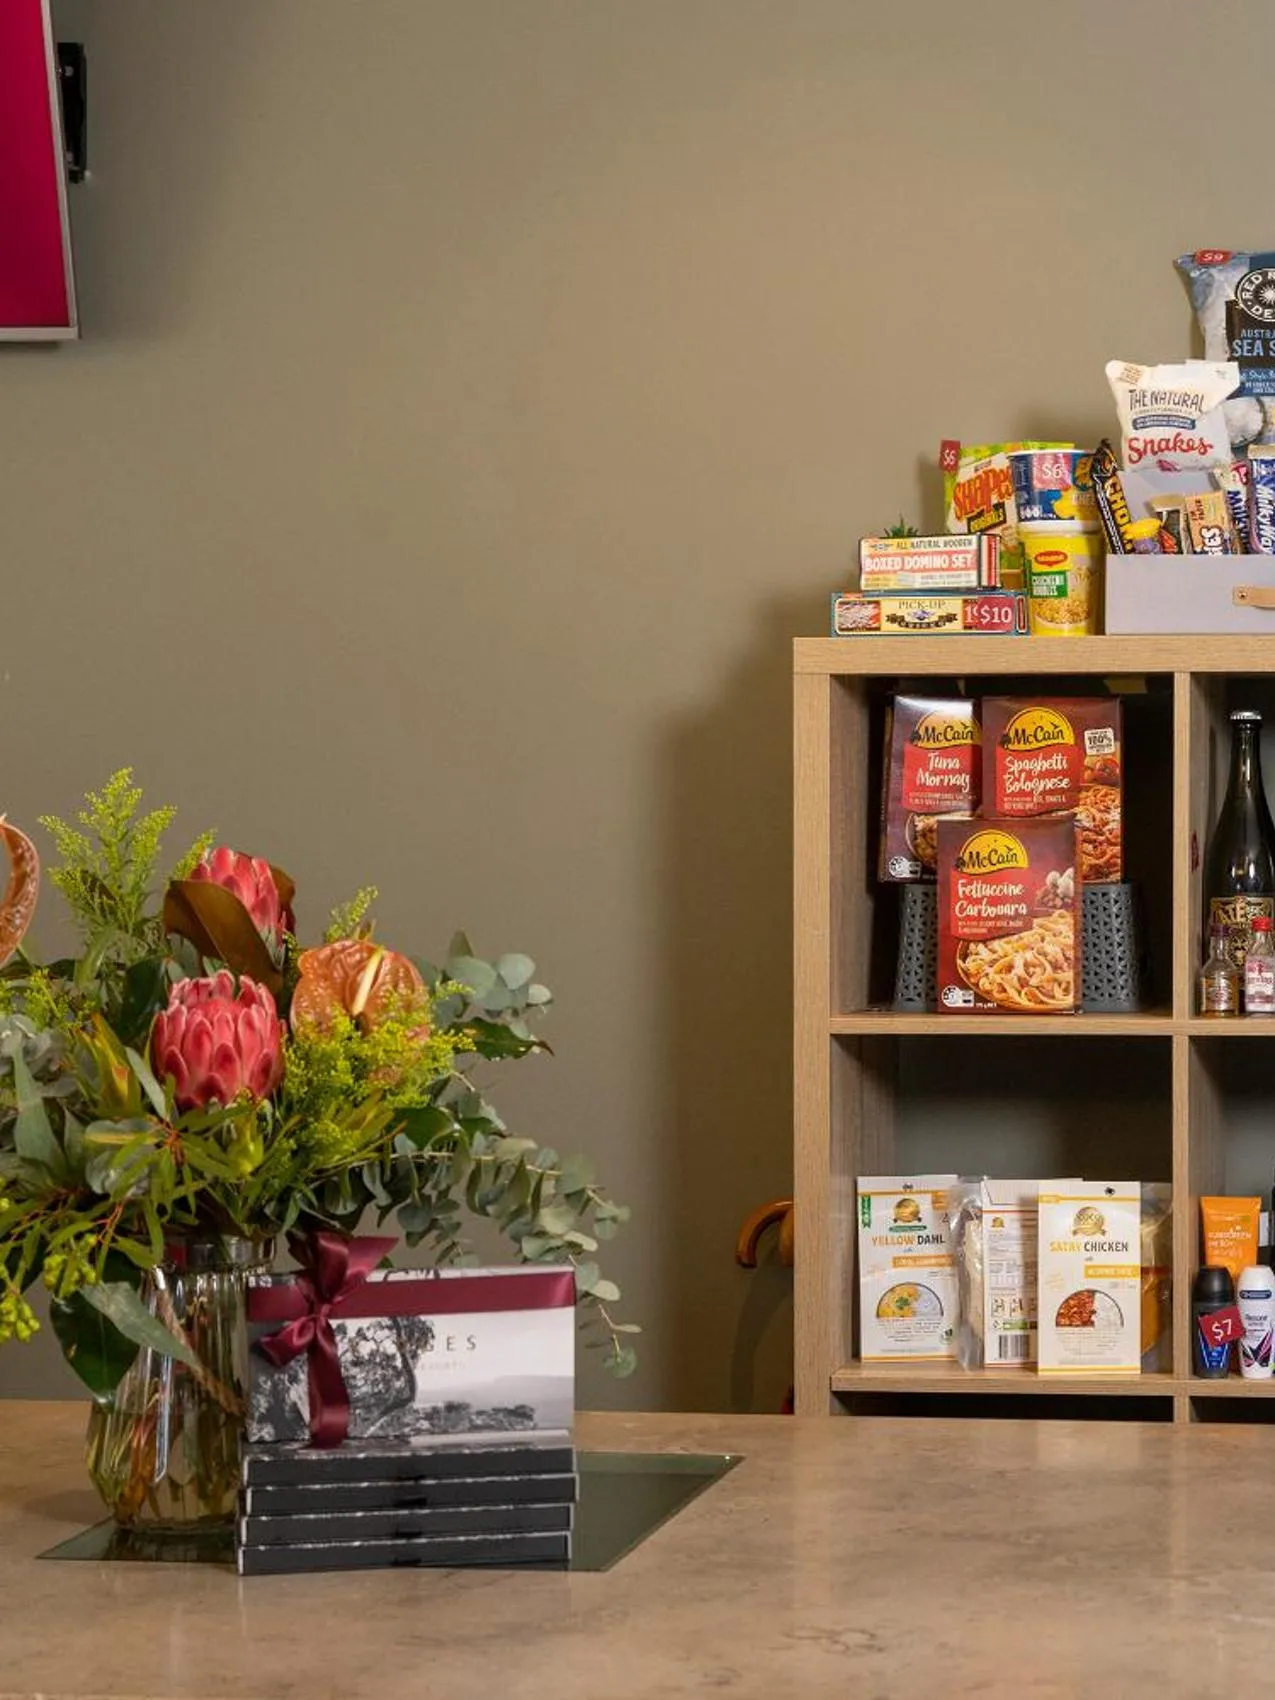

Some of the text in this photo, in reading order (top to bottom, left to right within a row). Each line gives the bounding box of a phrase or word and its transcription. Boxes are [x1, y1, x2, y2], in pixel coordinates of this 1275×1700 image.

[1242, 274, 1262, 299] RED
[1232, 340, 1264, 356] SEA
[1129, 389, 1205, 412] THE NATURAL
[1128, 432, 1213, 465] Snakes
[1042, 463, 1062, 478] $6
[864, 552, 973, 572] BOXED DOMINO SET
[899, 600, 946, 610] PICK-UP
[980, 607, 1012, 623] $10
[921, 725, 973, 745] McCain
[1010, 725, 1064, 745] McCain
[927, 752, 960, 769] Tuna
[1005, 753, 1068, 775] Spaghetti
[1003, 773, 1070, 796] Bolognese
[967, 850, 1018, 868] McCain
[957, 880, 1024, 898] Fettuccine
[955, 900, 1027, 918] Carbonara
[872, 1234, 946, 1246] YELLOW DAHL
[1084, 1241, 1129, 1252] CHICKEN
[1212, 1318, 1233, 1342] $7
